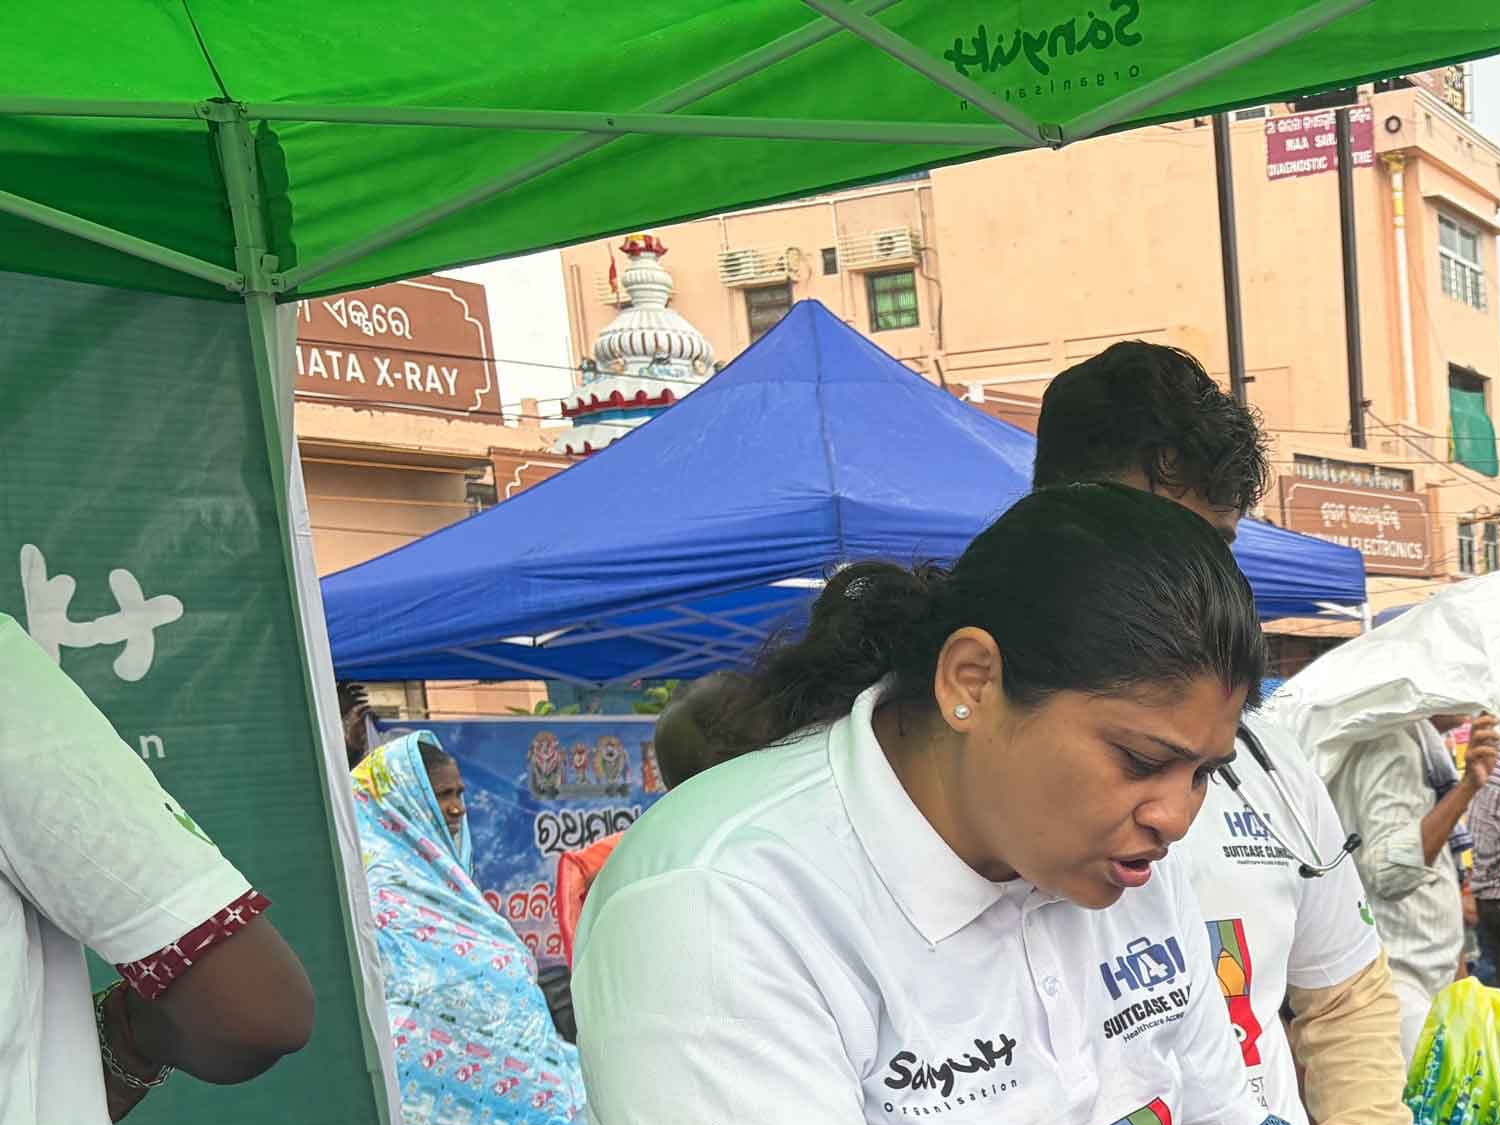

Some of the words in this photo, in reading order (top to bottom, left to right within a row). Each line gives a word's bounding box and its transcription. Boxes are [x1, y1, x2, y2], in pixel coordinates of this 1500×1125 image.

[296, 345, 366, 384] ATA
[374, 356, 458, 396] X-RAY
[1222, 845, 1265, 858] SUITCASE
[1103, 994, 1171, 1040] SUITCASE
[1122, 1018, 1165, 1043] Healthcare
[884, 1078, 1018, 1116] Organisation
